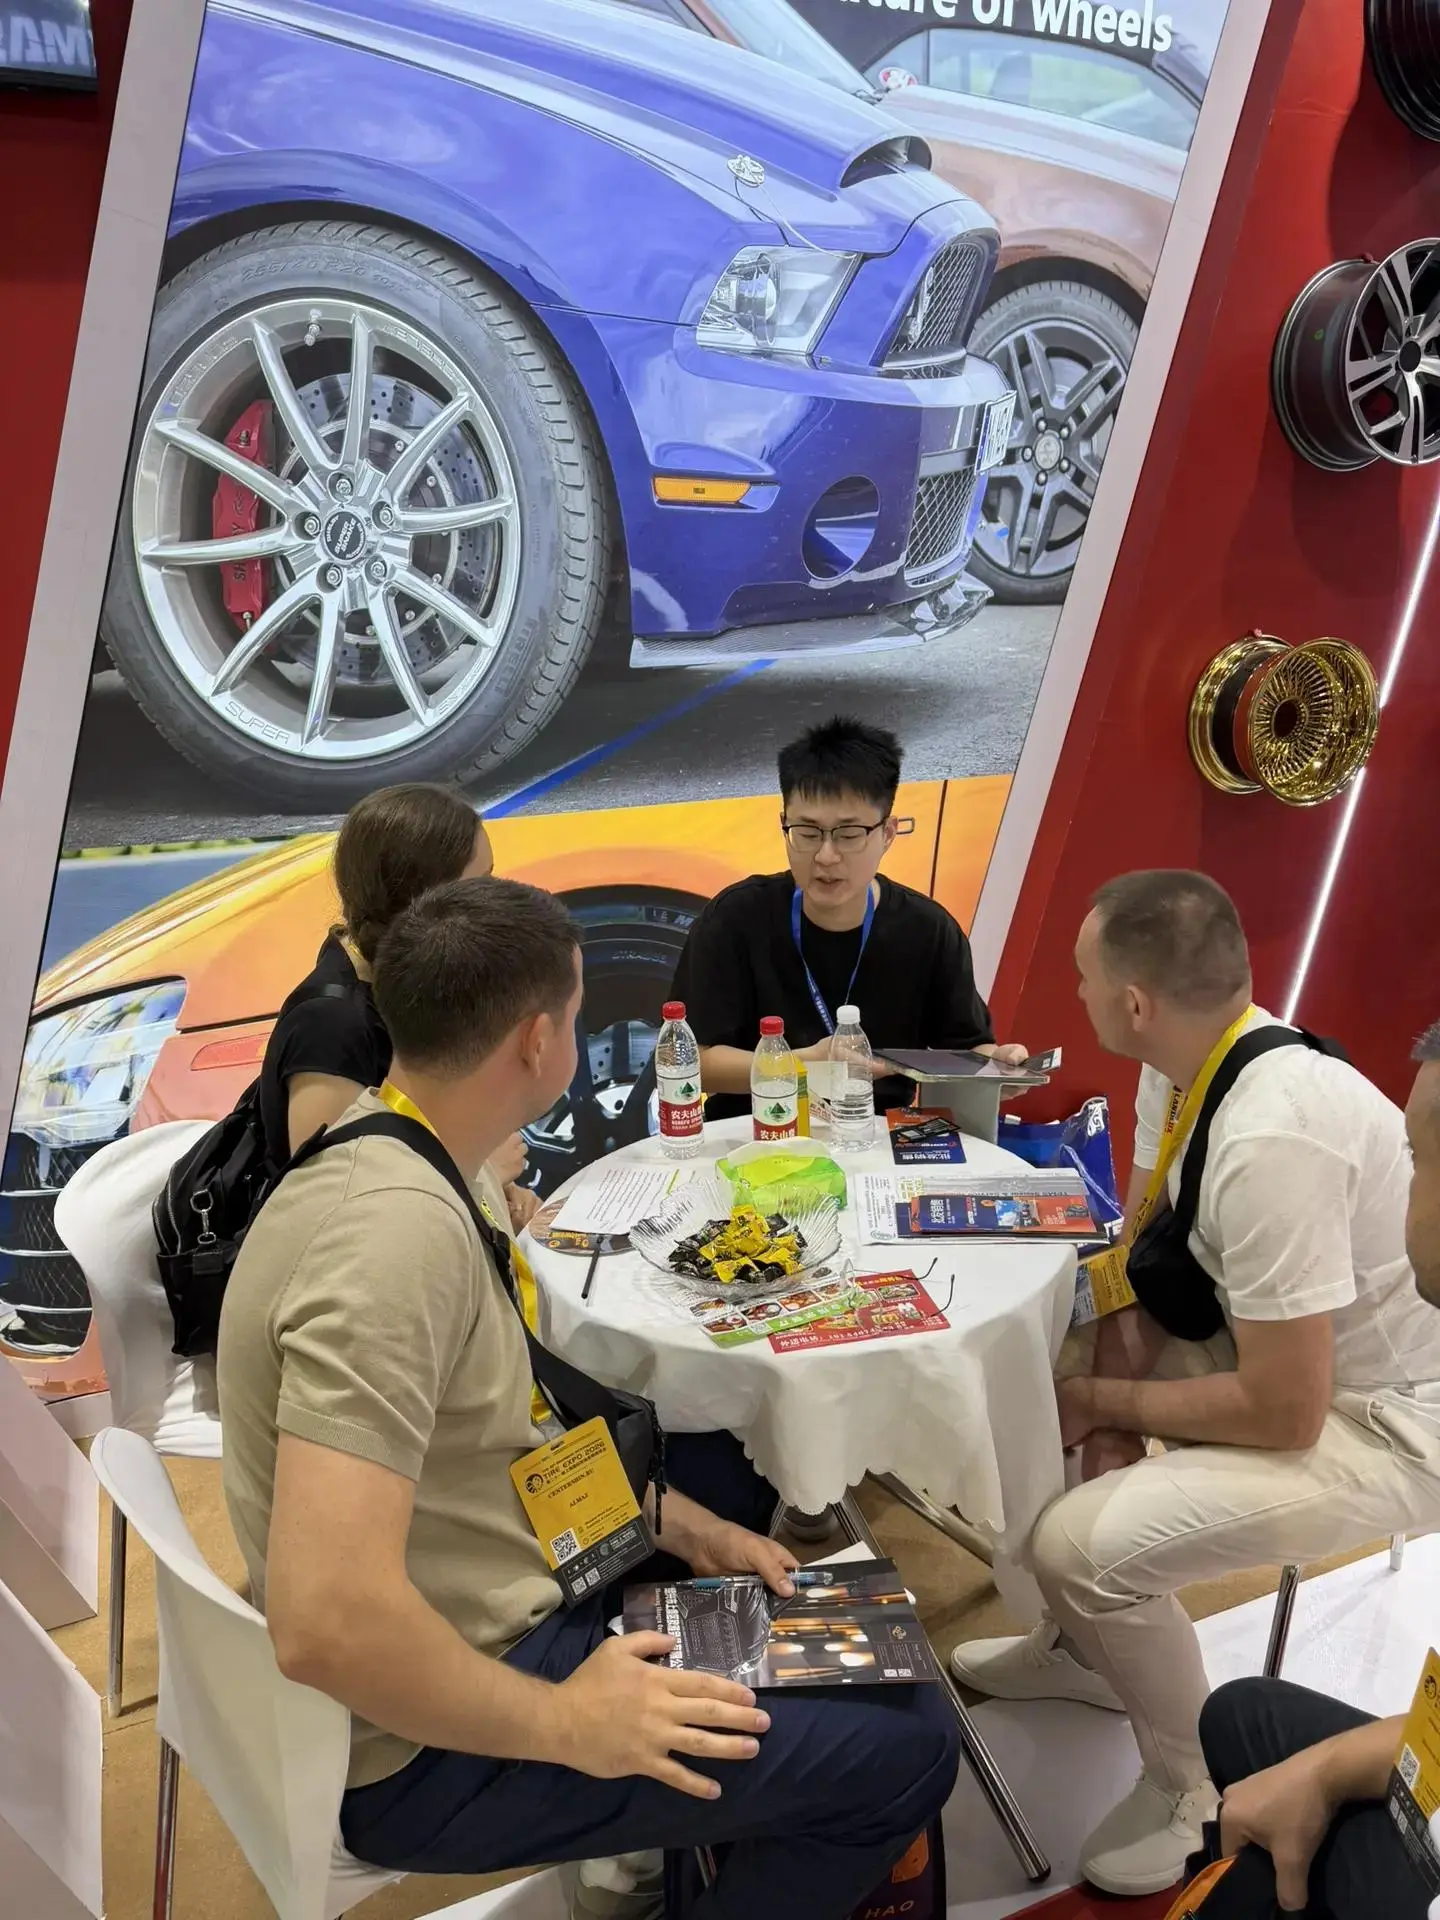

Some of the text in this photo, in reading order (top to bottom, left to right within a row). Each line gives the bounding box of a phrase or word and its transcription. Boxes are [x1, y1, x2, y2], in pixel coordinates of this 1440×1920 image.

[224, 700, 291, 745] SUPER
[543, 1465, 562, 1481] TIRE
[562, 1453, 583, 1470] EXPO
